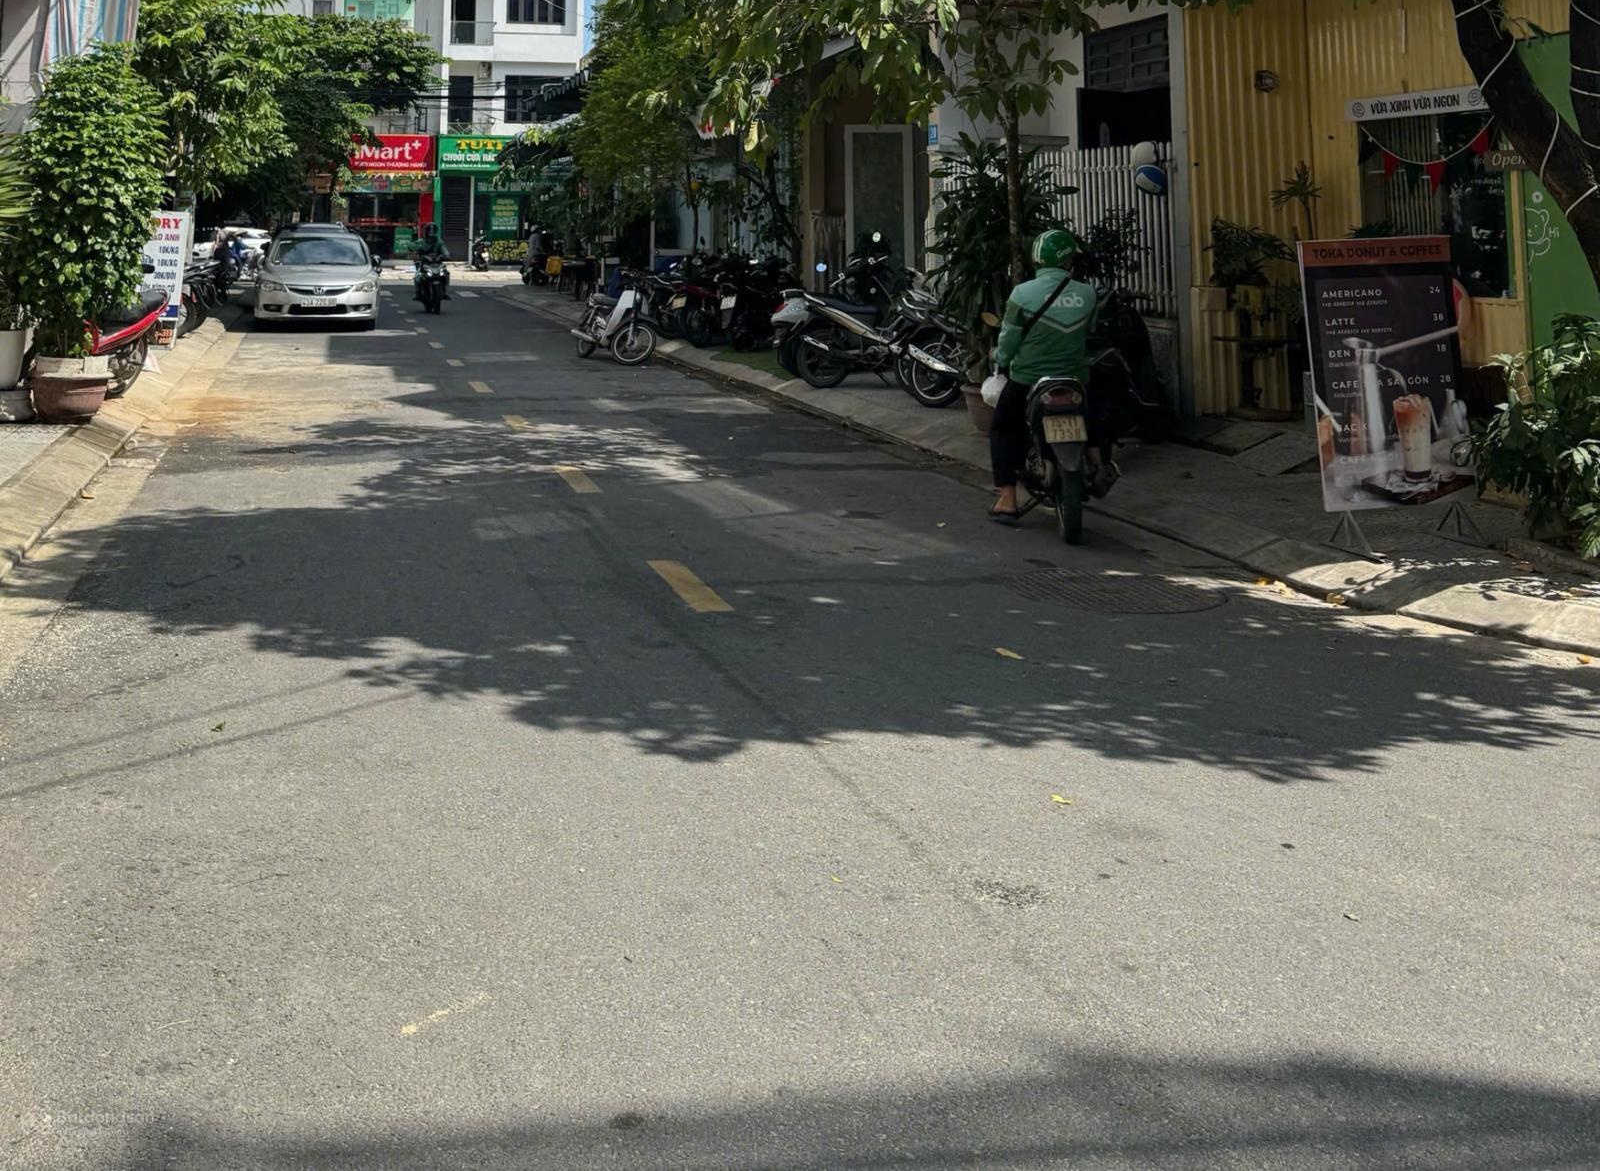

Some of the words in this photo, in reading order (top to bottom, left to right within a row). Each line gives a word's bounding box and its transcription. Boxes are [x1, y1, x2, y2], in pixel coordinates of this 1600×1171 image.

[1433, 94, 1460, 109] NGON
[1548, 227, 1560, 239] Hi
[1056, 246, 1073, 258] Grab
[1346, 247, 1386, 259] DONUT
[1399, 244, 1441, 256] COFFEE
[1322, 288, 1383, 299] AMERICANO
[1429, 286, 1441, 294] 24
[1325, 318, 1356, 327] LATTE
